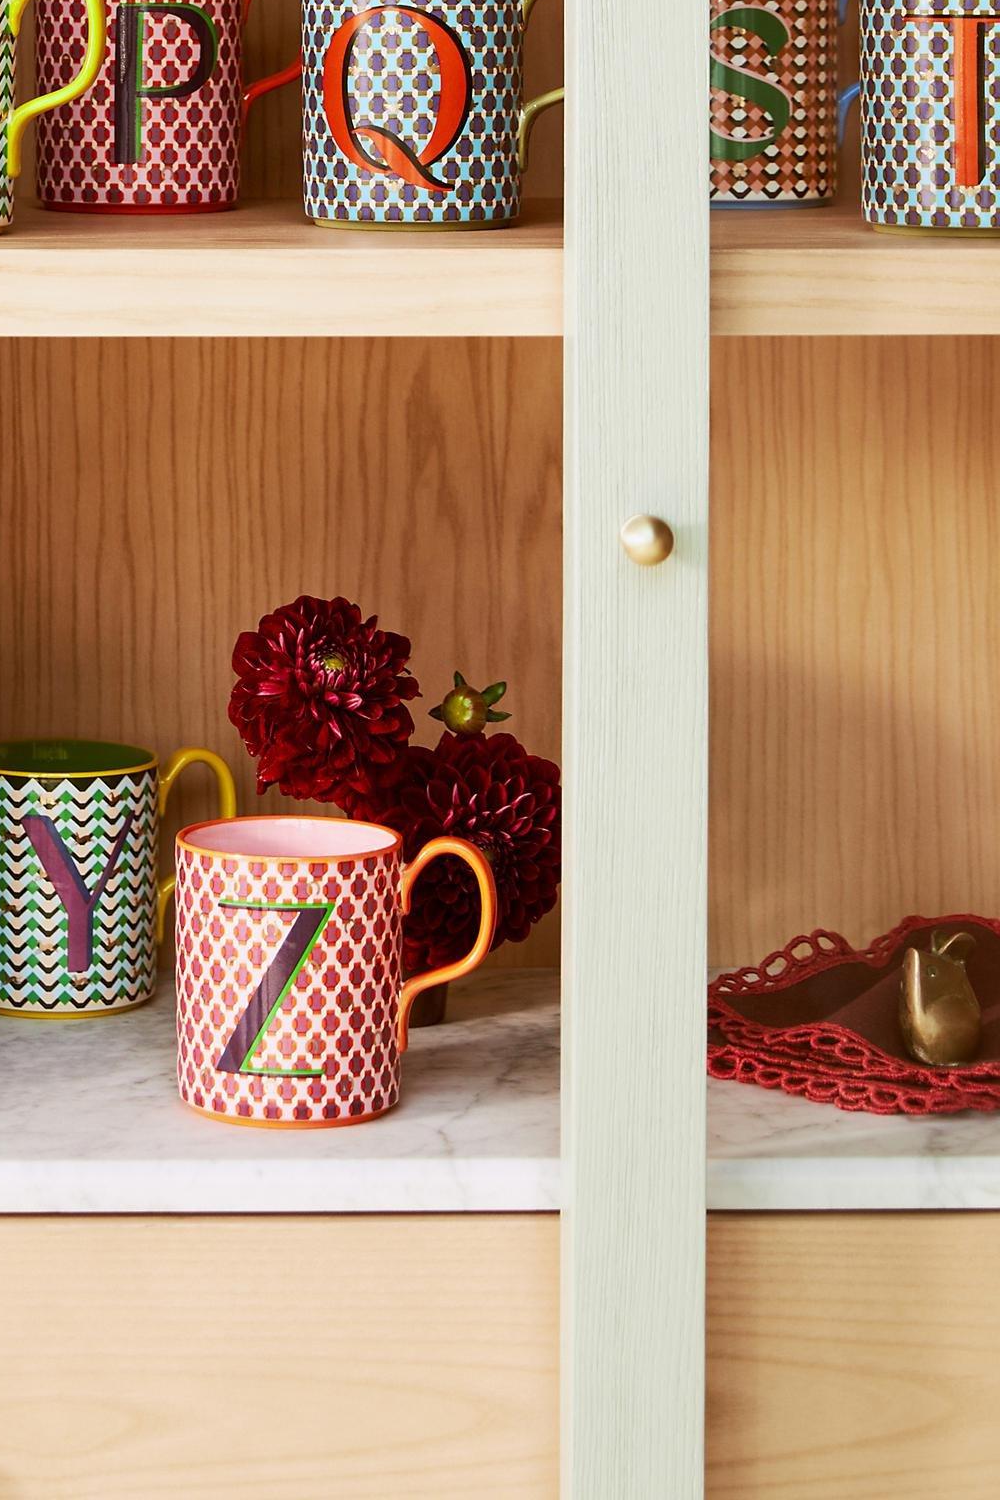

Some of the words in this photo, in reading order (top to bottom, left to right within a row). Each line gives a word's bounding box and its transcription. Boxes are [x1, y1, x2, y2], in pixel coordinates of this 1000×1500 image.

[114, 2, 218, 164] P
[323, 4, 473, 192] Q
[710, 4, 792, 160] S
[902, 14, 1000, 186] T
[22, 811, 135, 972] Y
[218, 899, 336, 1077] Z
